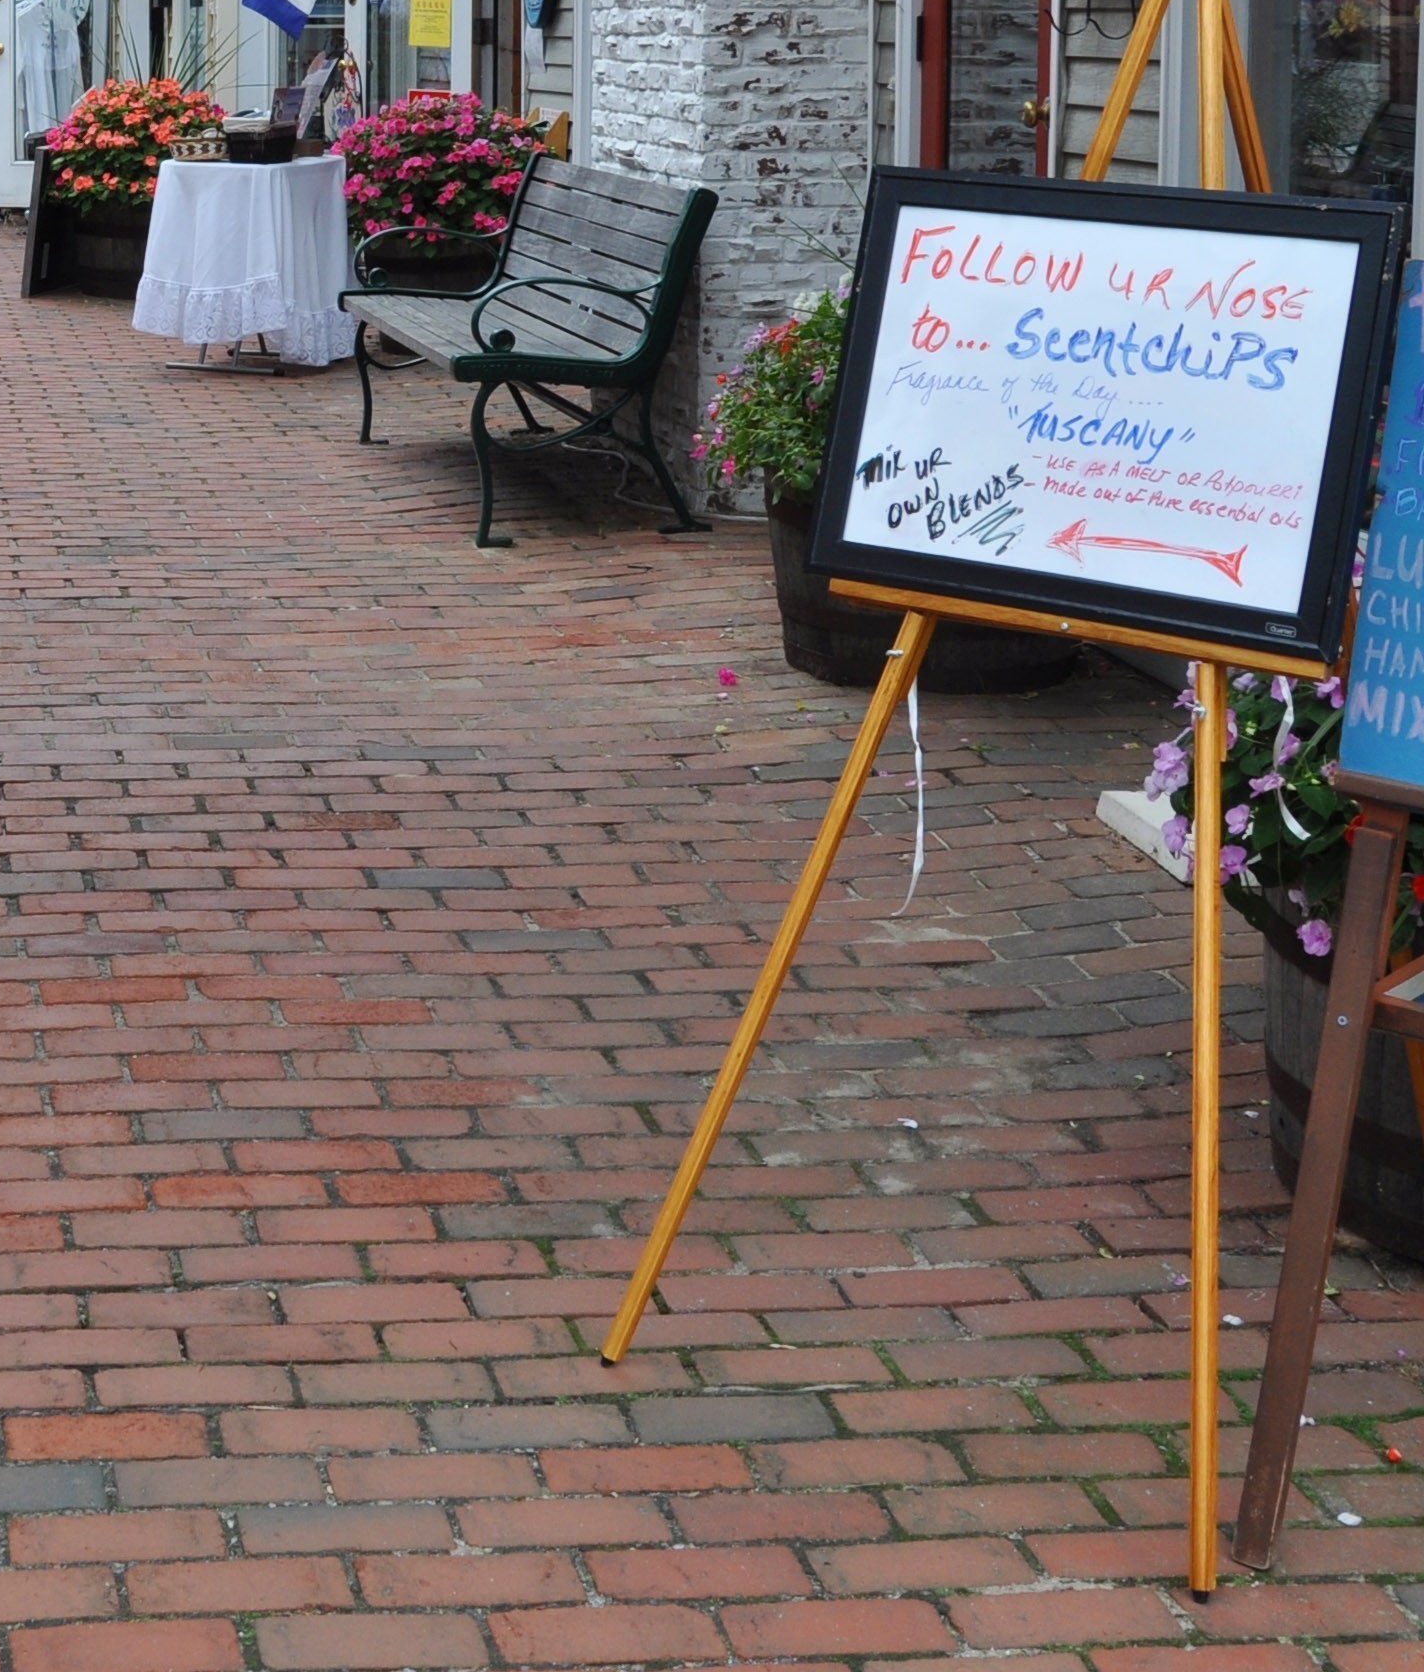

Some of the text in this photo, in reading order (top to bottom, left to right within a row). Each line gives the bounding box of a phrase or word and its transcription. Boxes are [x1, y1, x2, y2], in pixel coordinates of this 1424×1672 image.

[1185, 258, 1313, 320] NOSE
[886, 360, 990, 406] Fragrance
[1002, 376, 1016, 403] of
